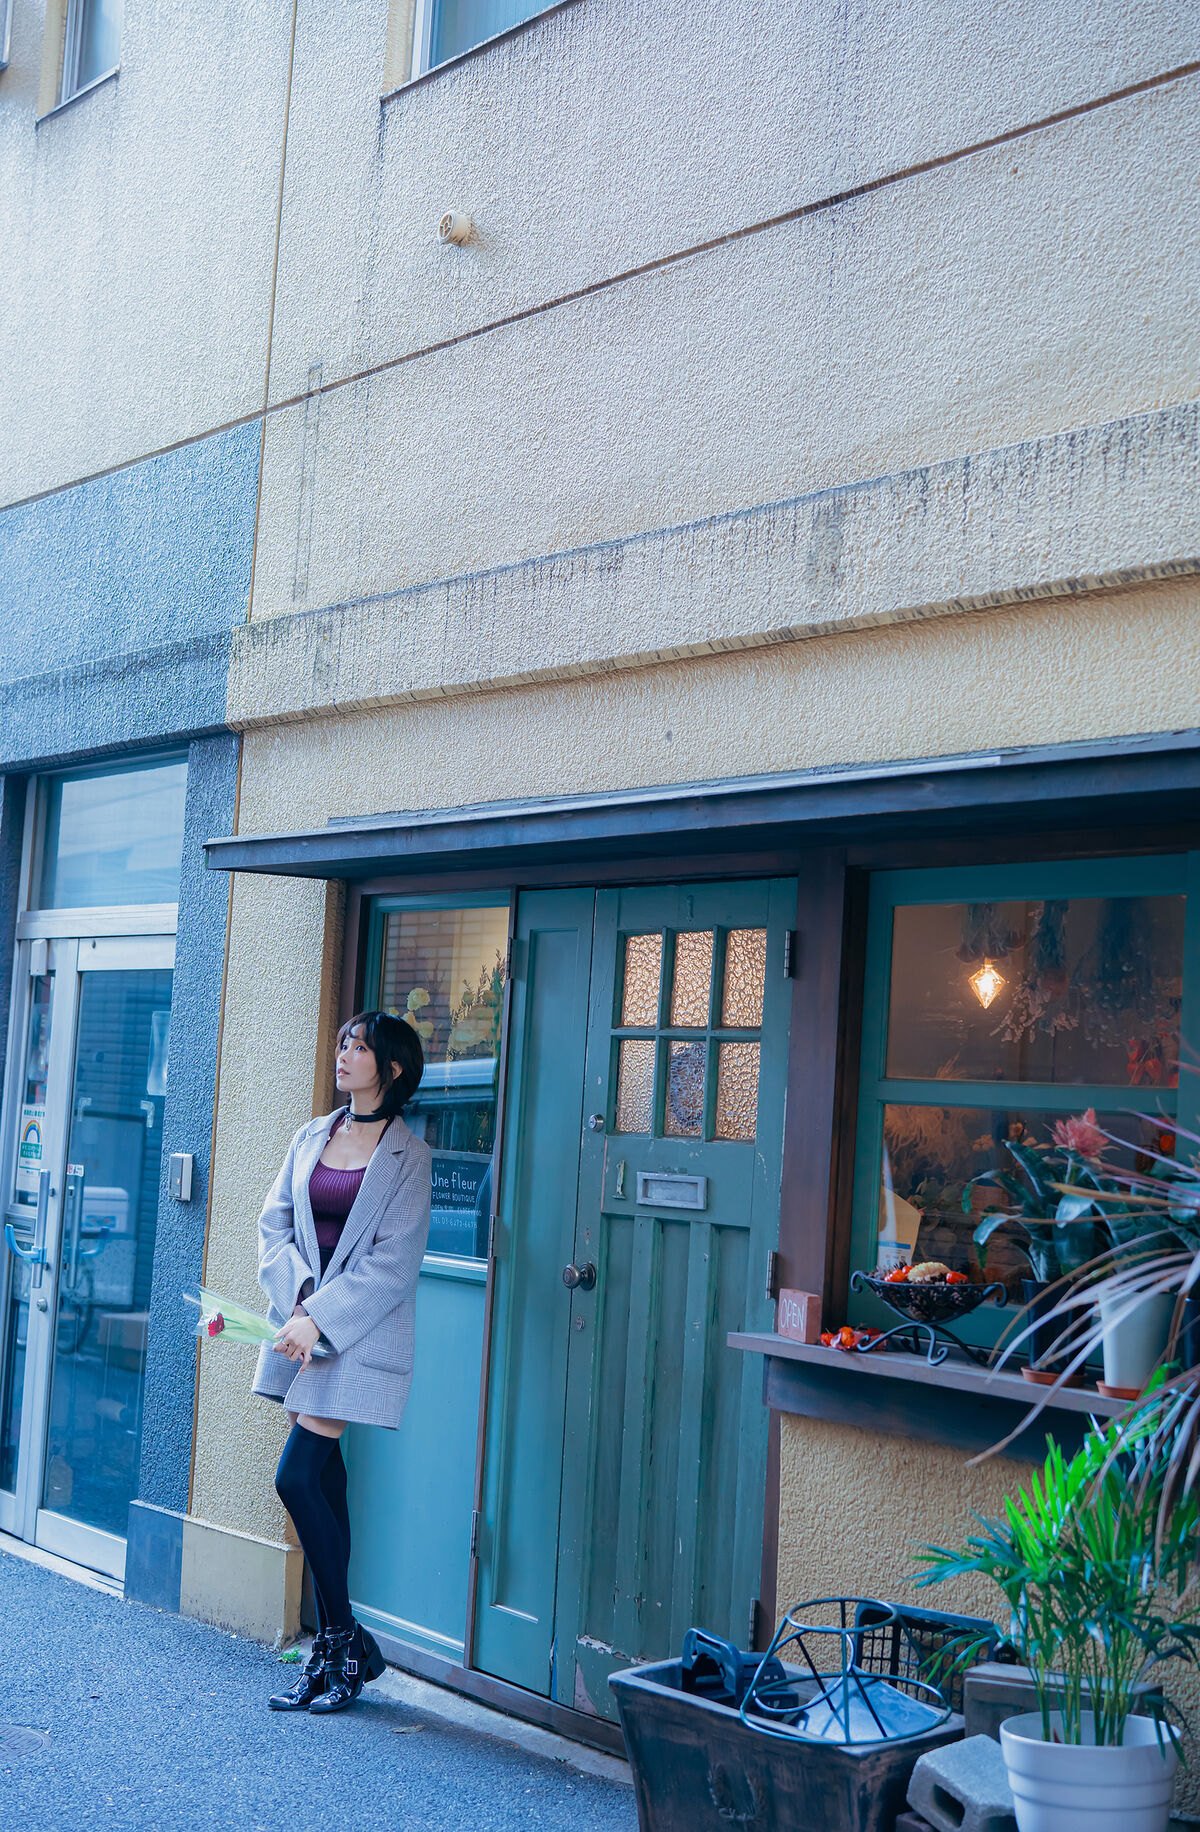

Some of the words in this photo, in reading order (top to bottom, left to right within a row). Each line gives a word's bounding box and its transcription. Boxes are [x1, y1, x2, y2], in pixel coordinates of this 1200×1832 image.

[431, 1172, 449, 1188] Une
[451, 1171, 477, 1190] fleur
[432, 1191, 451, 1200] FLOWER
[452, 1193, 475, 1203] BOUTIQUE
[781, 1298, 804, 1332] OPEN
